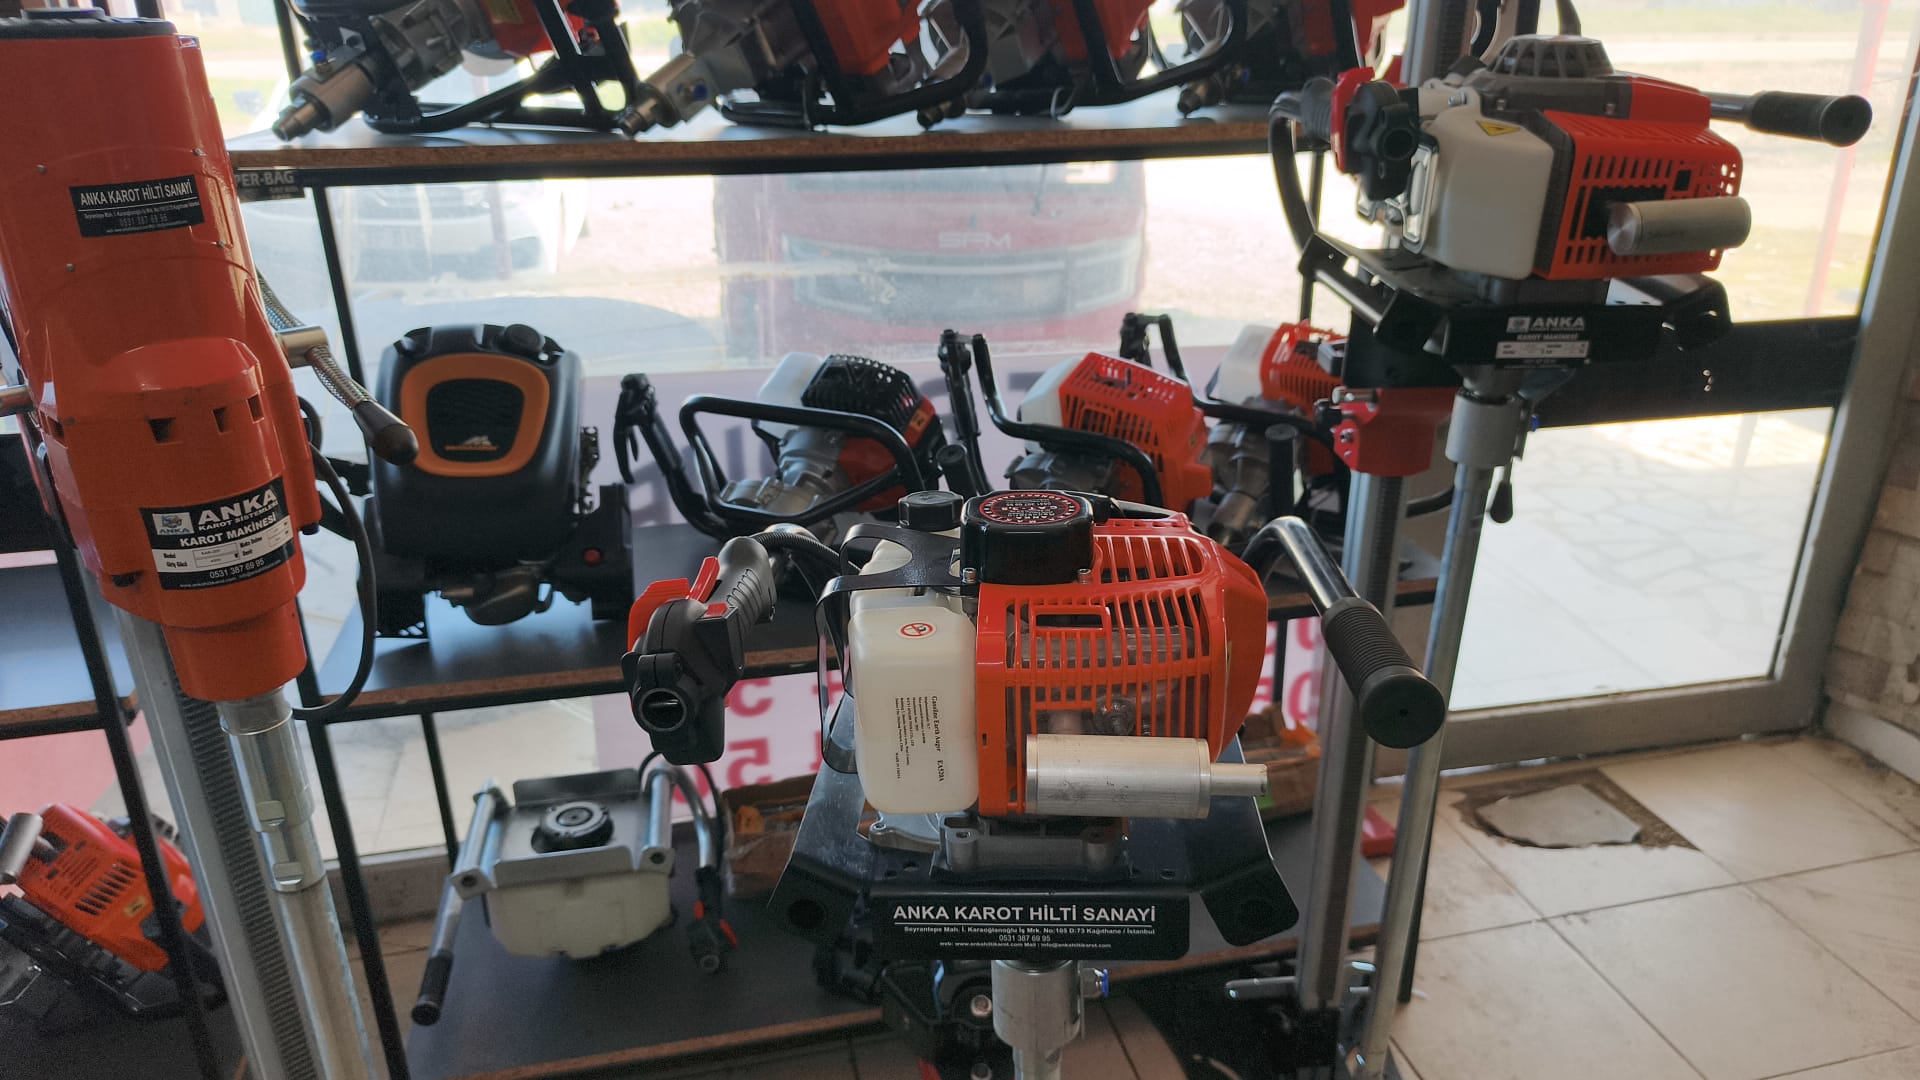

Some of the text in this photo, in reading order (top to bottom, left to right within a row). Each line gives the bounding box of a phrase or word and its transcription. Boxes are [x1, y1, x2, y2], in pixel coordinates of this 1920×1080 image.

[80, 178, 193, 206] ANKA KAROT HİLTİ SANAYİ
[1532, 316, 1584, 329] ANKA
[198, 489, 278, 525] ANKA
[180, 533, 223, 547] KAROT
[226, 511, 277, 538] MAKİNESİ
[198, 520, 232, 531] KAROT
[209, 567, 228, 579] 0531
[231, 564, 243, 575] 387
[245, 561, 254, 571] 69
[255, 558, 265, 568] 95
[893, 904, 1156, 922] ANKA KAROT HİLTİ SANAYİ
[999, 934, 1016, 942] 0531
